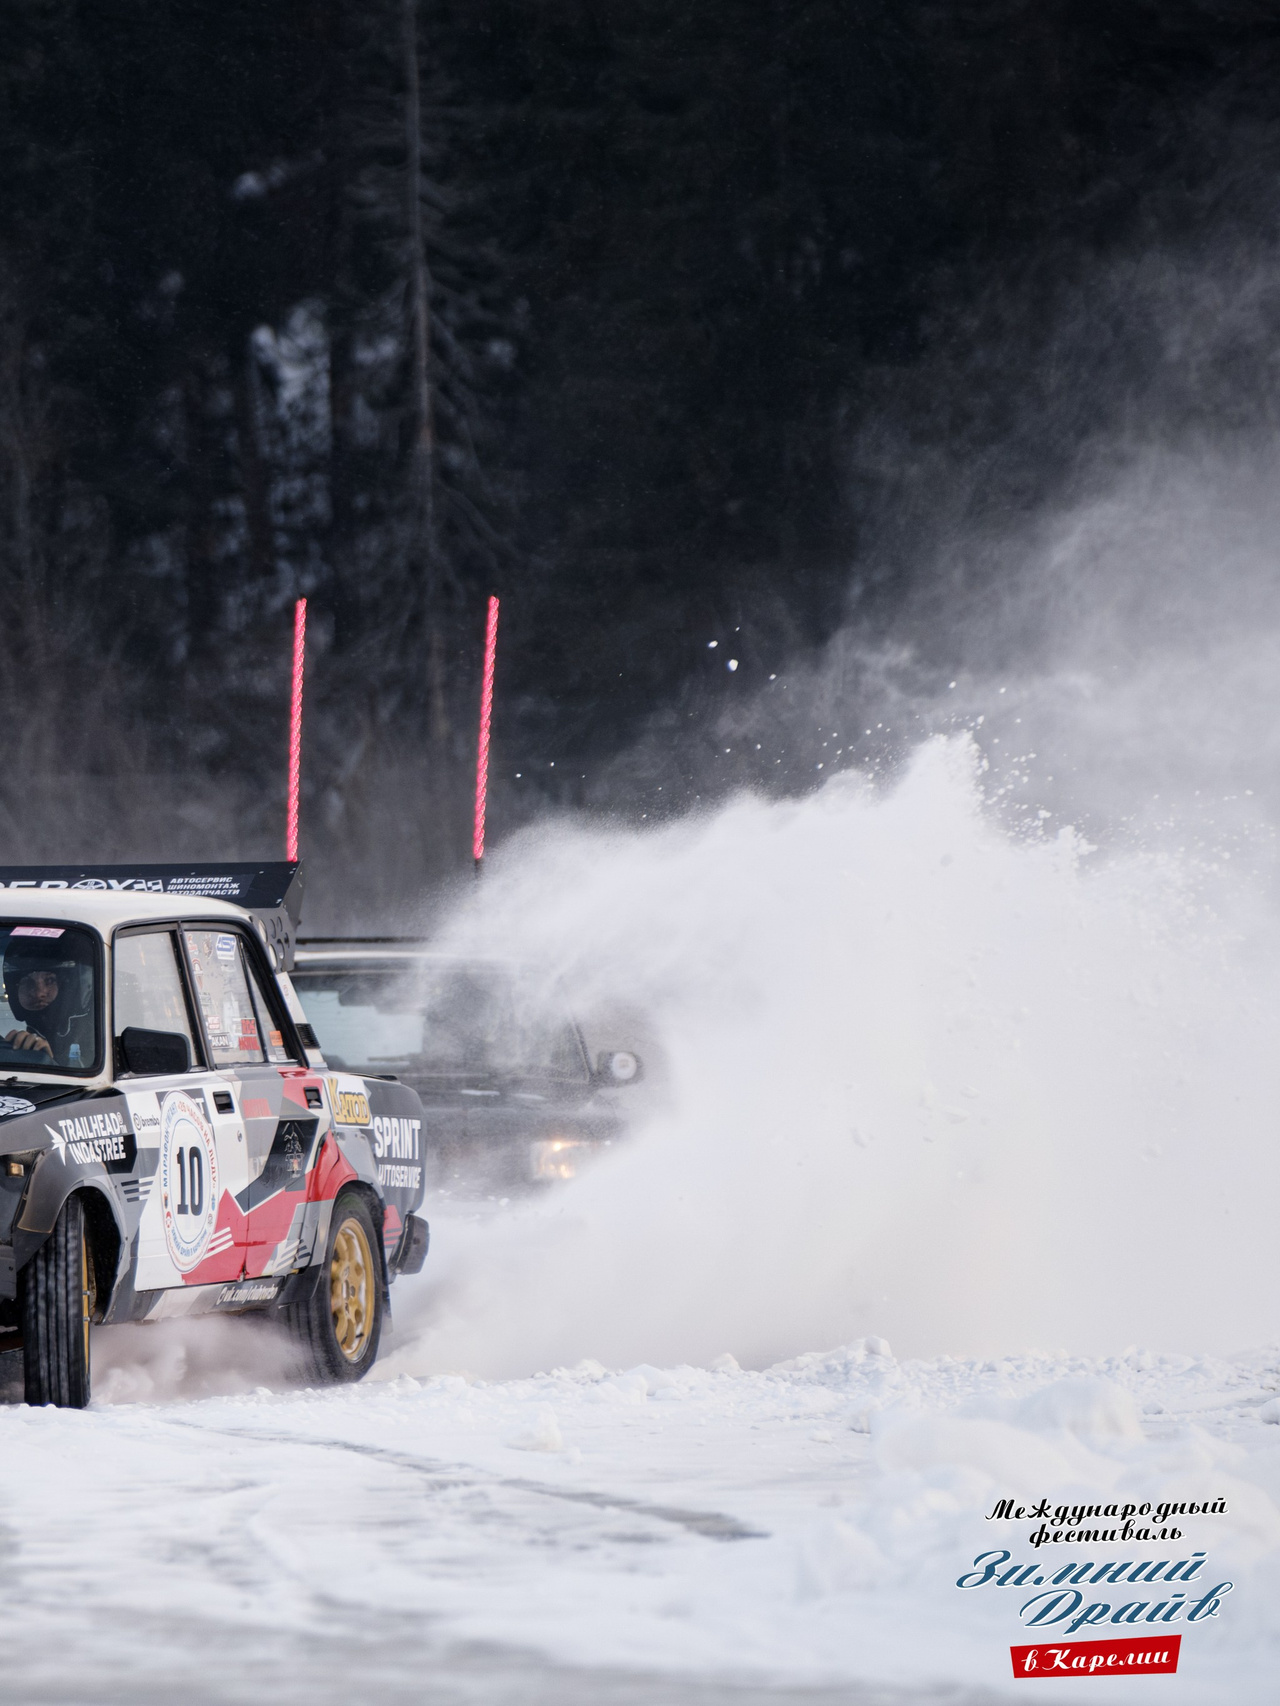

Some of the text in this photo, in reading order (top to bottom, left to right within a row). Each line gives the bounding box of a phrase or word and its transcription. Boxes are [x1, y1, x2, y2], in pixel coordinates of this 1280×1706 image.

[167, 882, 240, 890] ШИНОМОНТАЖ
[67, 1136, 126, 1165] INDASTREE
[373, 1117, 421, 1160] SPRINT
[177, 1146, 203, 1216] 10
